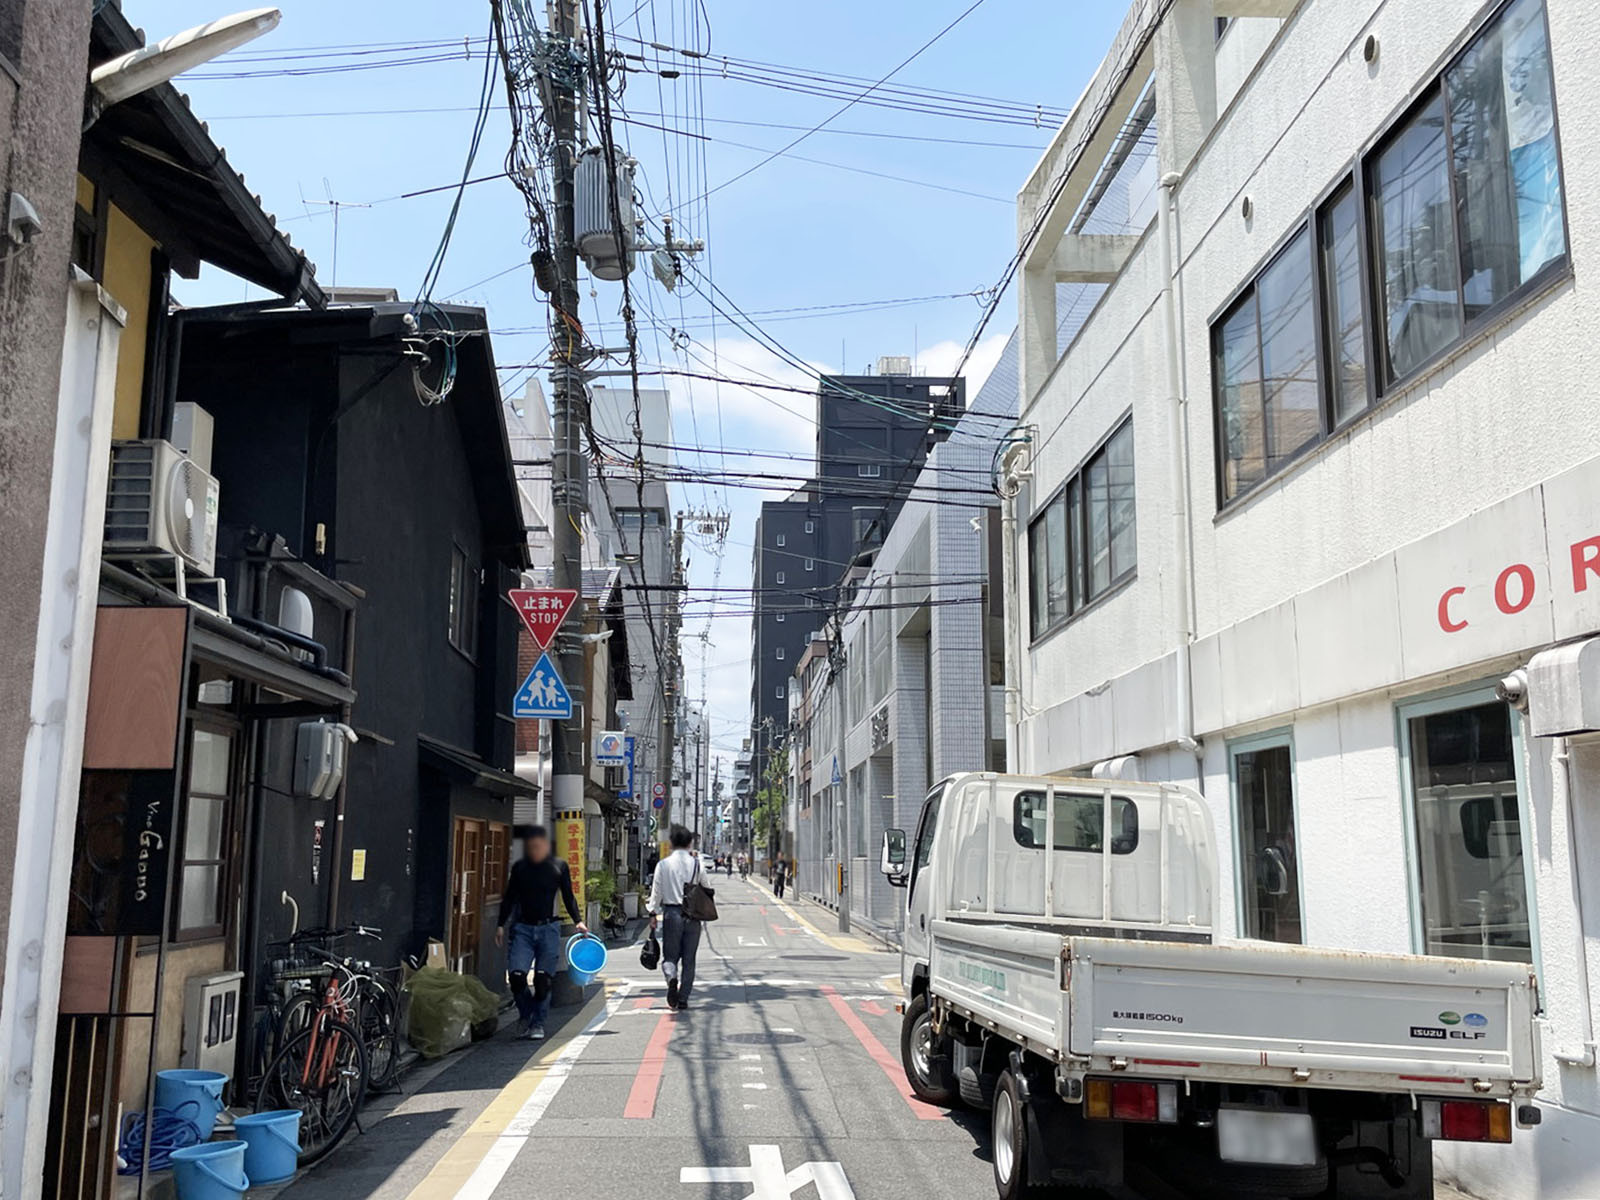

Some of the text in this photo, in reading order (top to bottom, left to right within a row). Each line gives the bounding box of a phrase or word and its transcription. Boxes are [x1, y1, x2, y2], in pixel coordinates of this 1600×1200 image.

[1437, 535, 1600, 633] COR
[523, 596, 565, 610] 止まれ
[530, 612, 559, 624] STOP
[1413, 1029, 1486, 1040] ISUZU ELF
